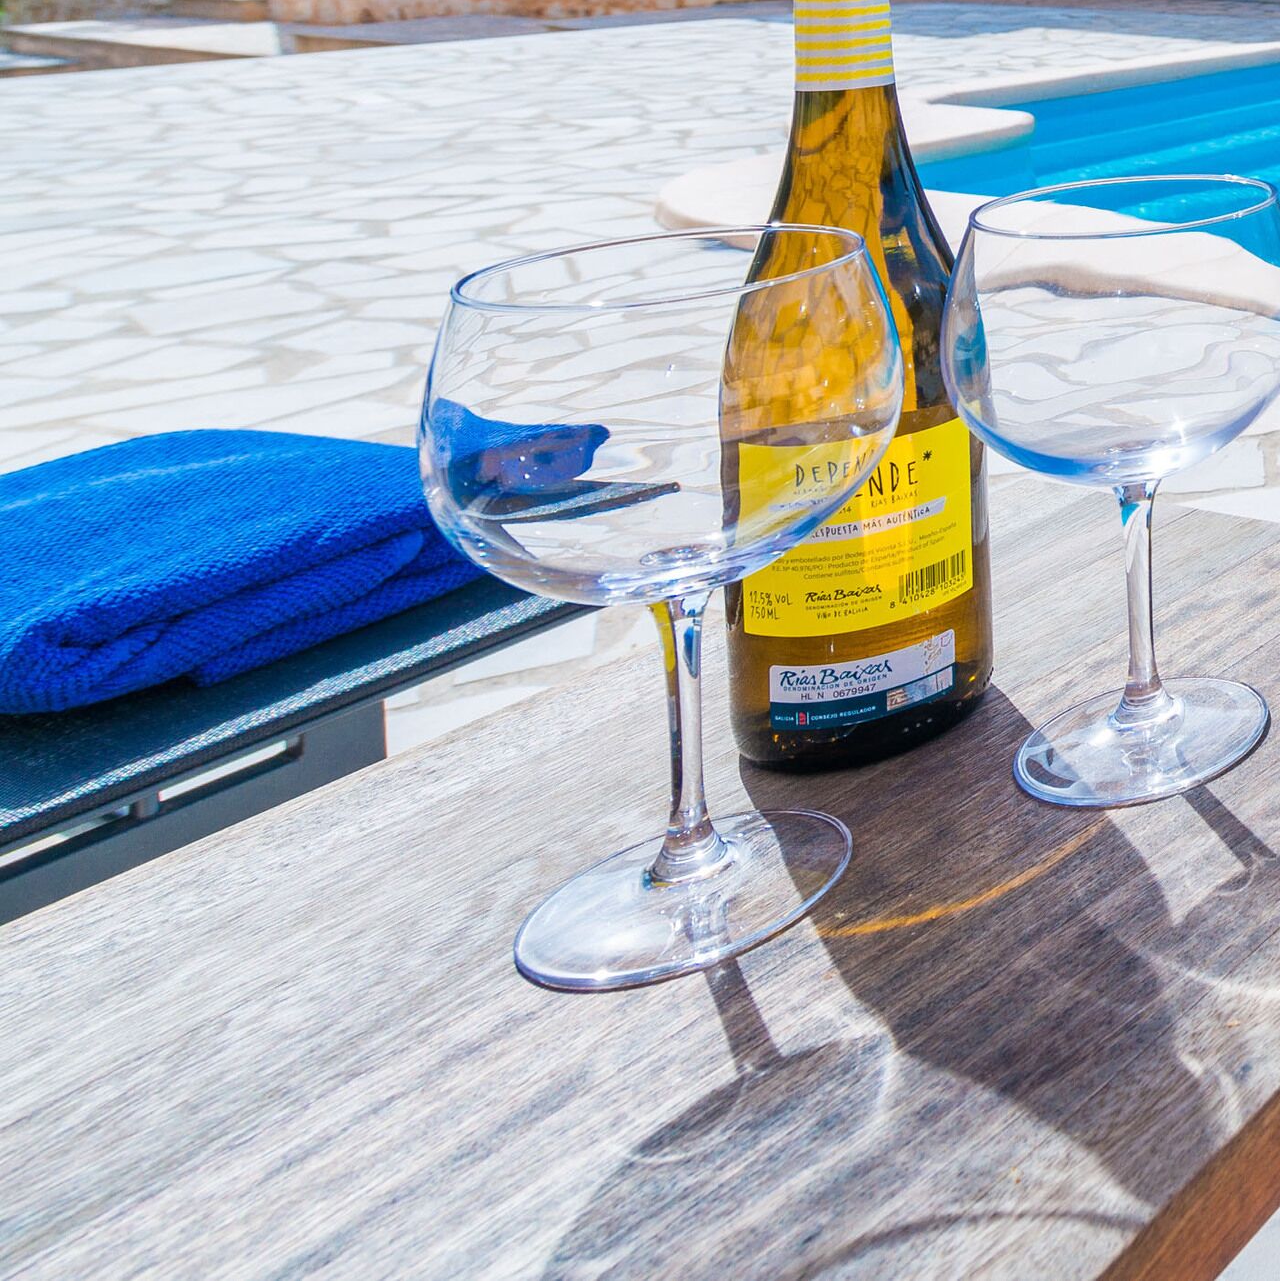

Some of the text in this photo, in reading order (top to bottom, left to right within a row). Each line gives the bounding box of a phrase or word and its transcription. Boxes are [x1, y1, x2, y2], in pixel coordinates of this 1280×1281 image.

[832, 554, 843, 563] por
[803, 572, 833, 580] Contiene
[834, 584, 882, 600] Baixas
[890, 600, 896, 609] 8
[820, 659, 893, 685] Baixas
[857, 673, 888, 685] ORIGEN
[800, 683, 877, 701] HL N 0679947
